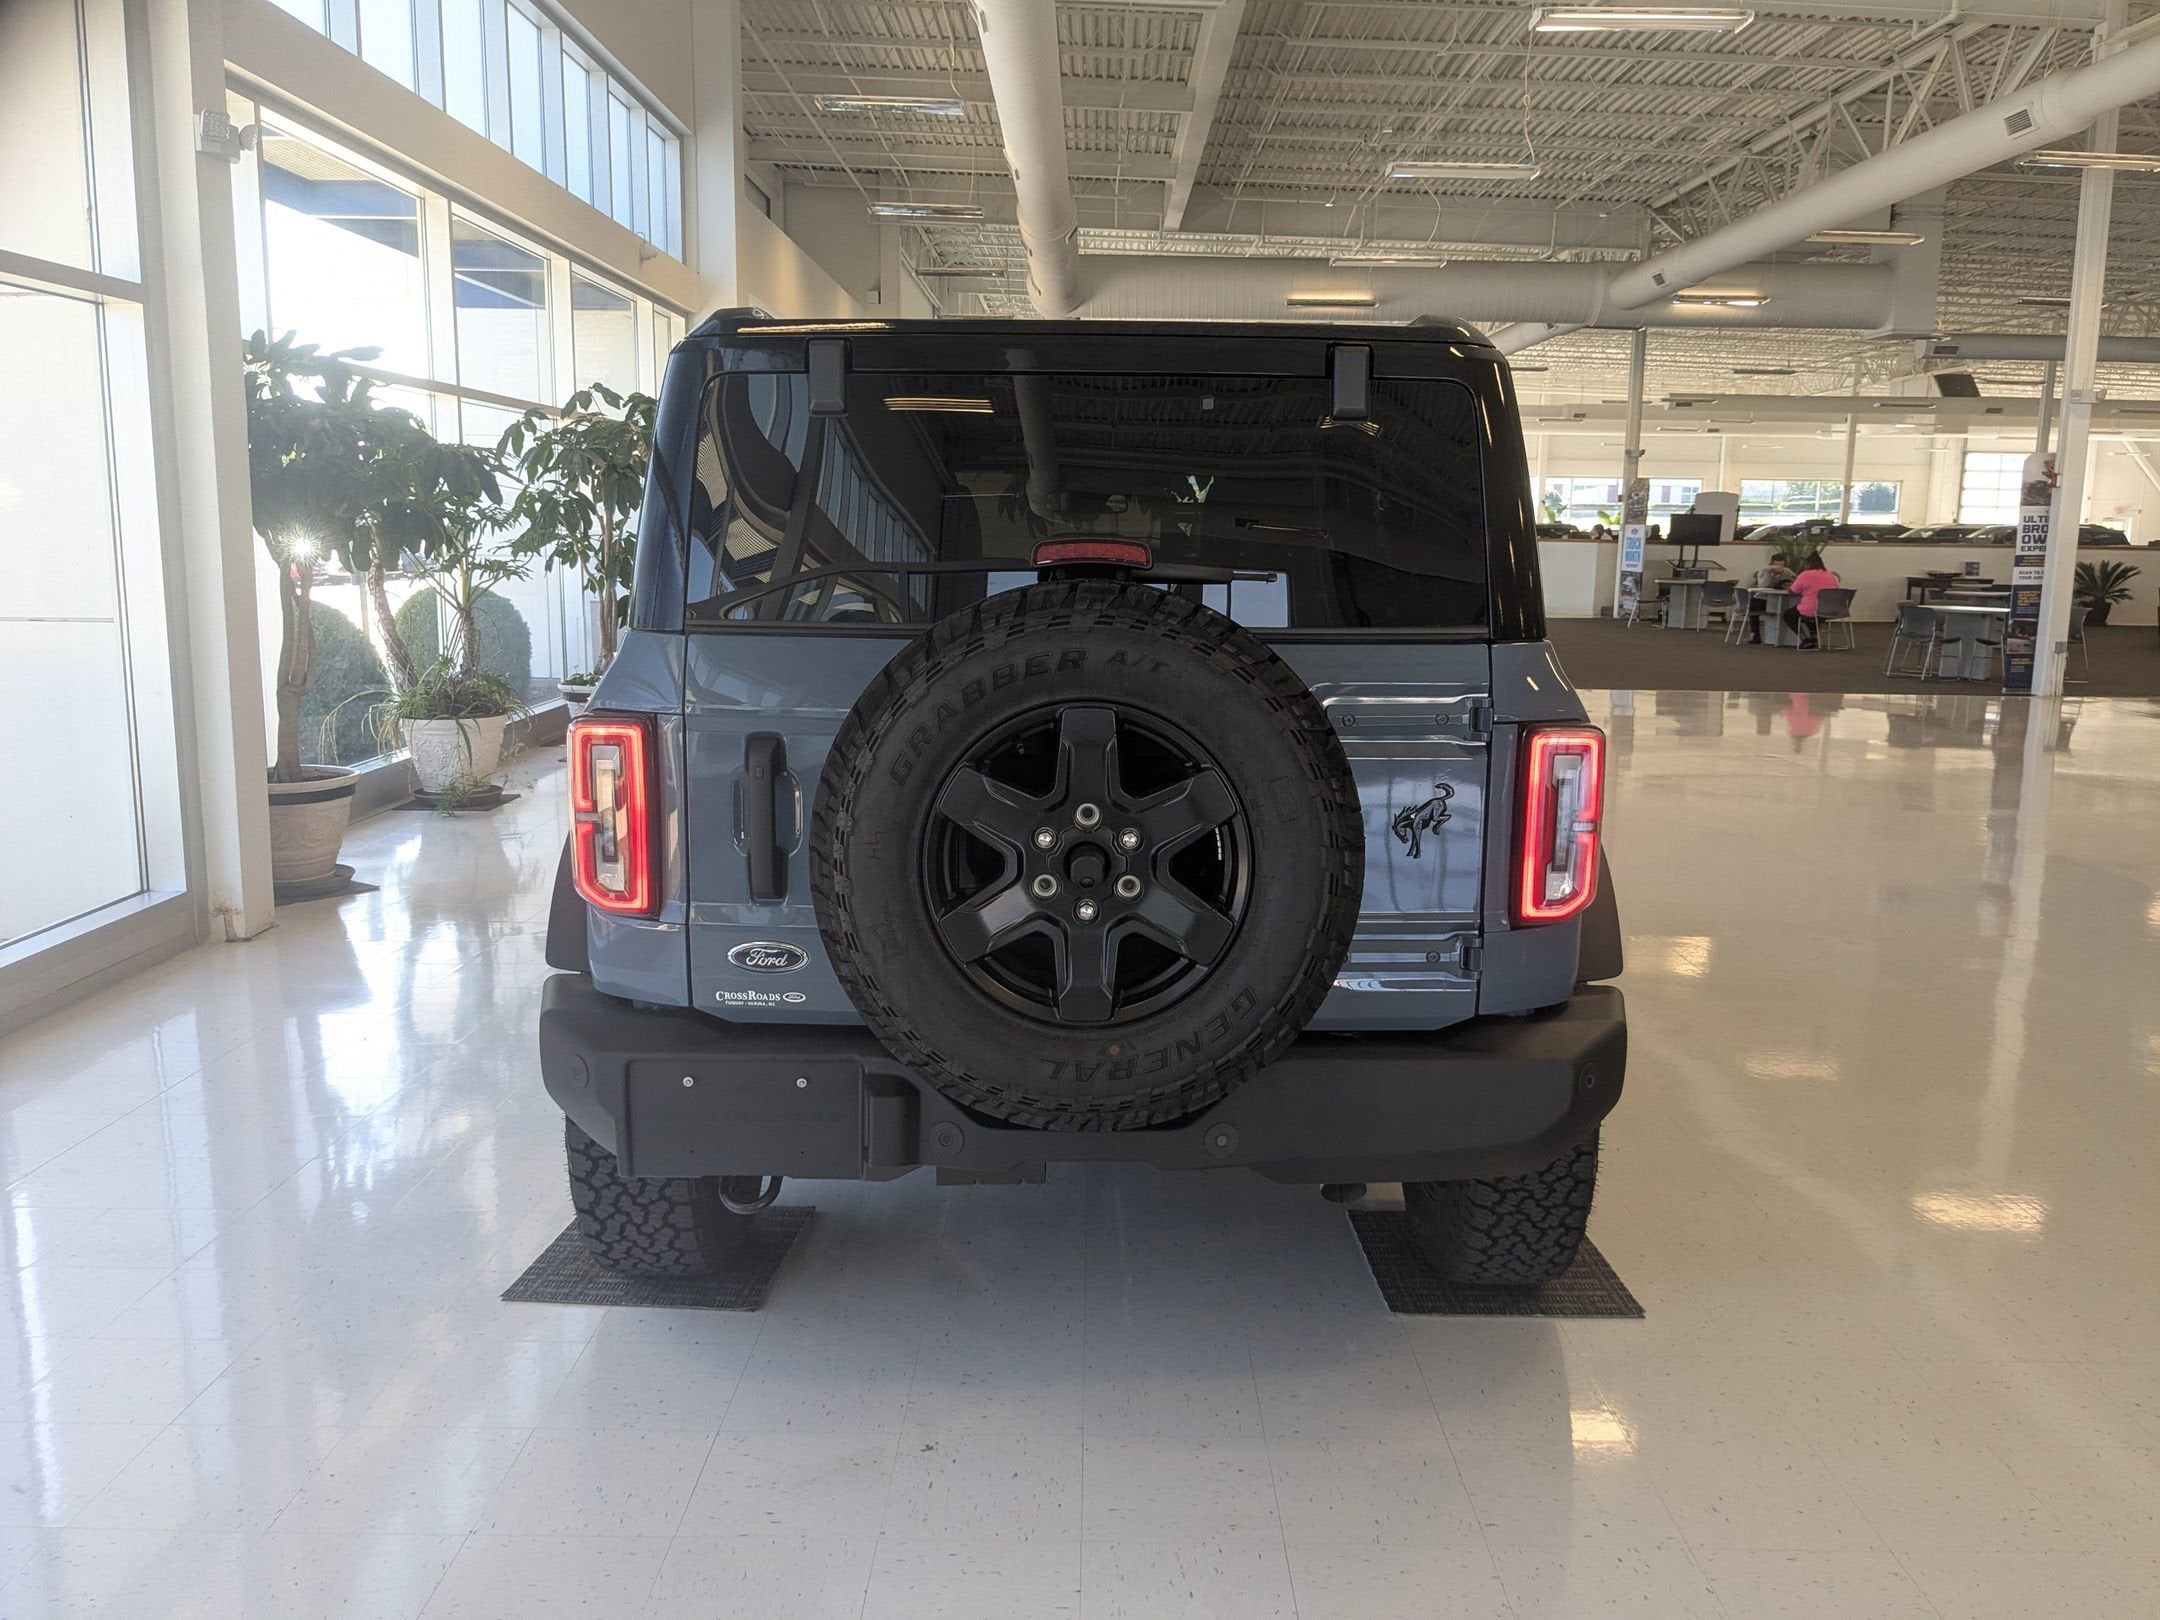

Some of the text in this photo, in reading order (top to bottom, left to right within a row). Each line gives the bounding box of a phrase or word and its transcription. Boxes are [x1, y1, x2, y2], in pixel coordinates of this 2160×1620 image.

[888, 647, 1090, 786] GRABBER
[745, 948, 788, 967] Ford
[1039, 983, 1259, 1084] GENERAL
